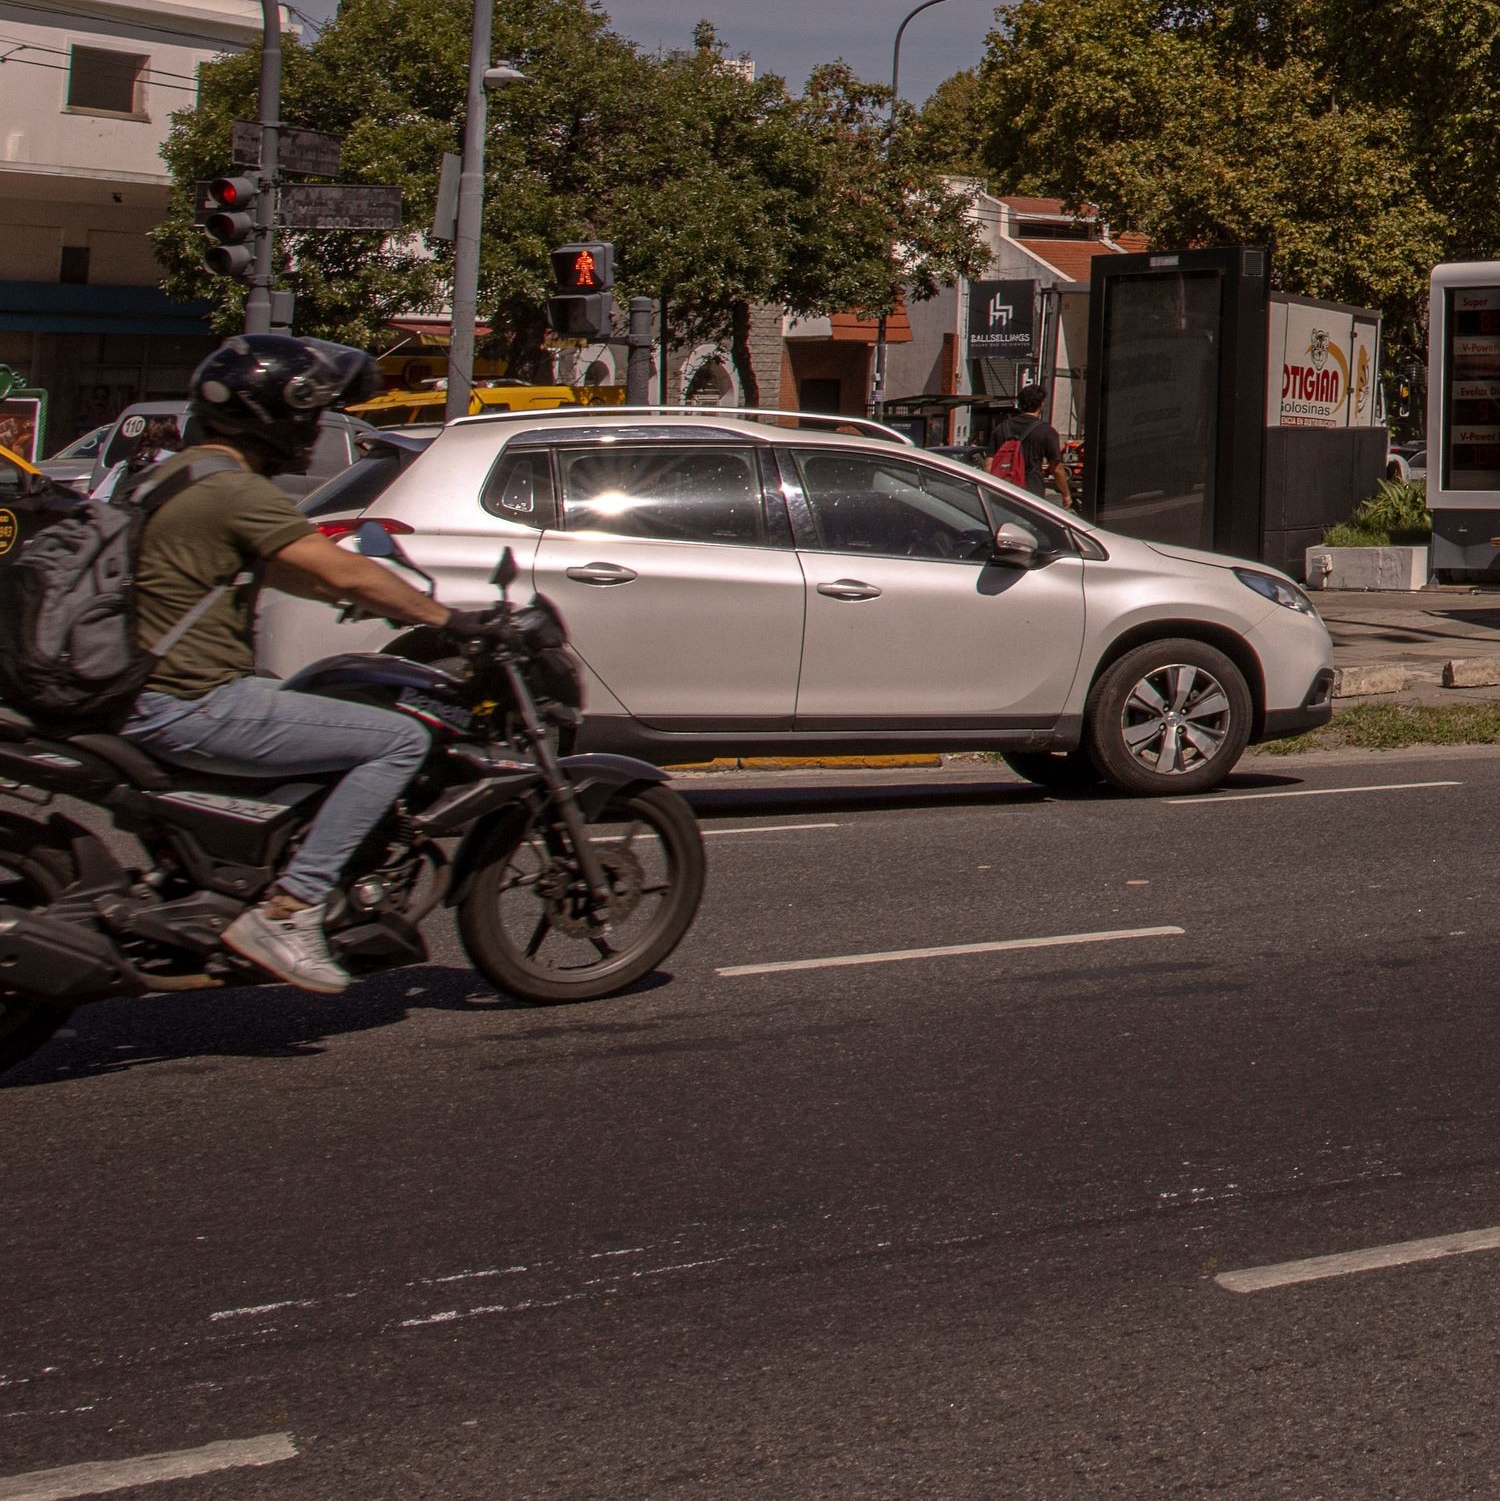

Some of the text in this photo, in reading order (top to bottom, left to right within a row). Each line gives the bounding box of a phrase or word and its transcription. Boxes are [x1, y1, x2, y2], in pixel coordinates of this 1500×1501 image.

[1463, 297, 1489, 308] Super
[1462, 343, 1498, 353] V-Power
[1460, 386, 1488, 396] Evolux
[124, 420, 143, 434] 110
[1460, 431, 1496, 441] V-Power
